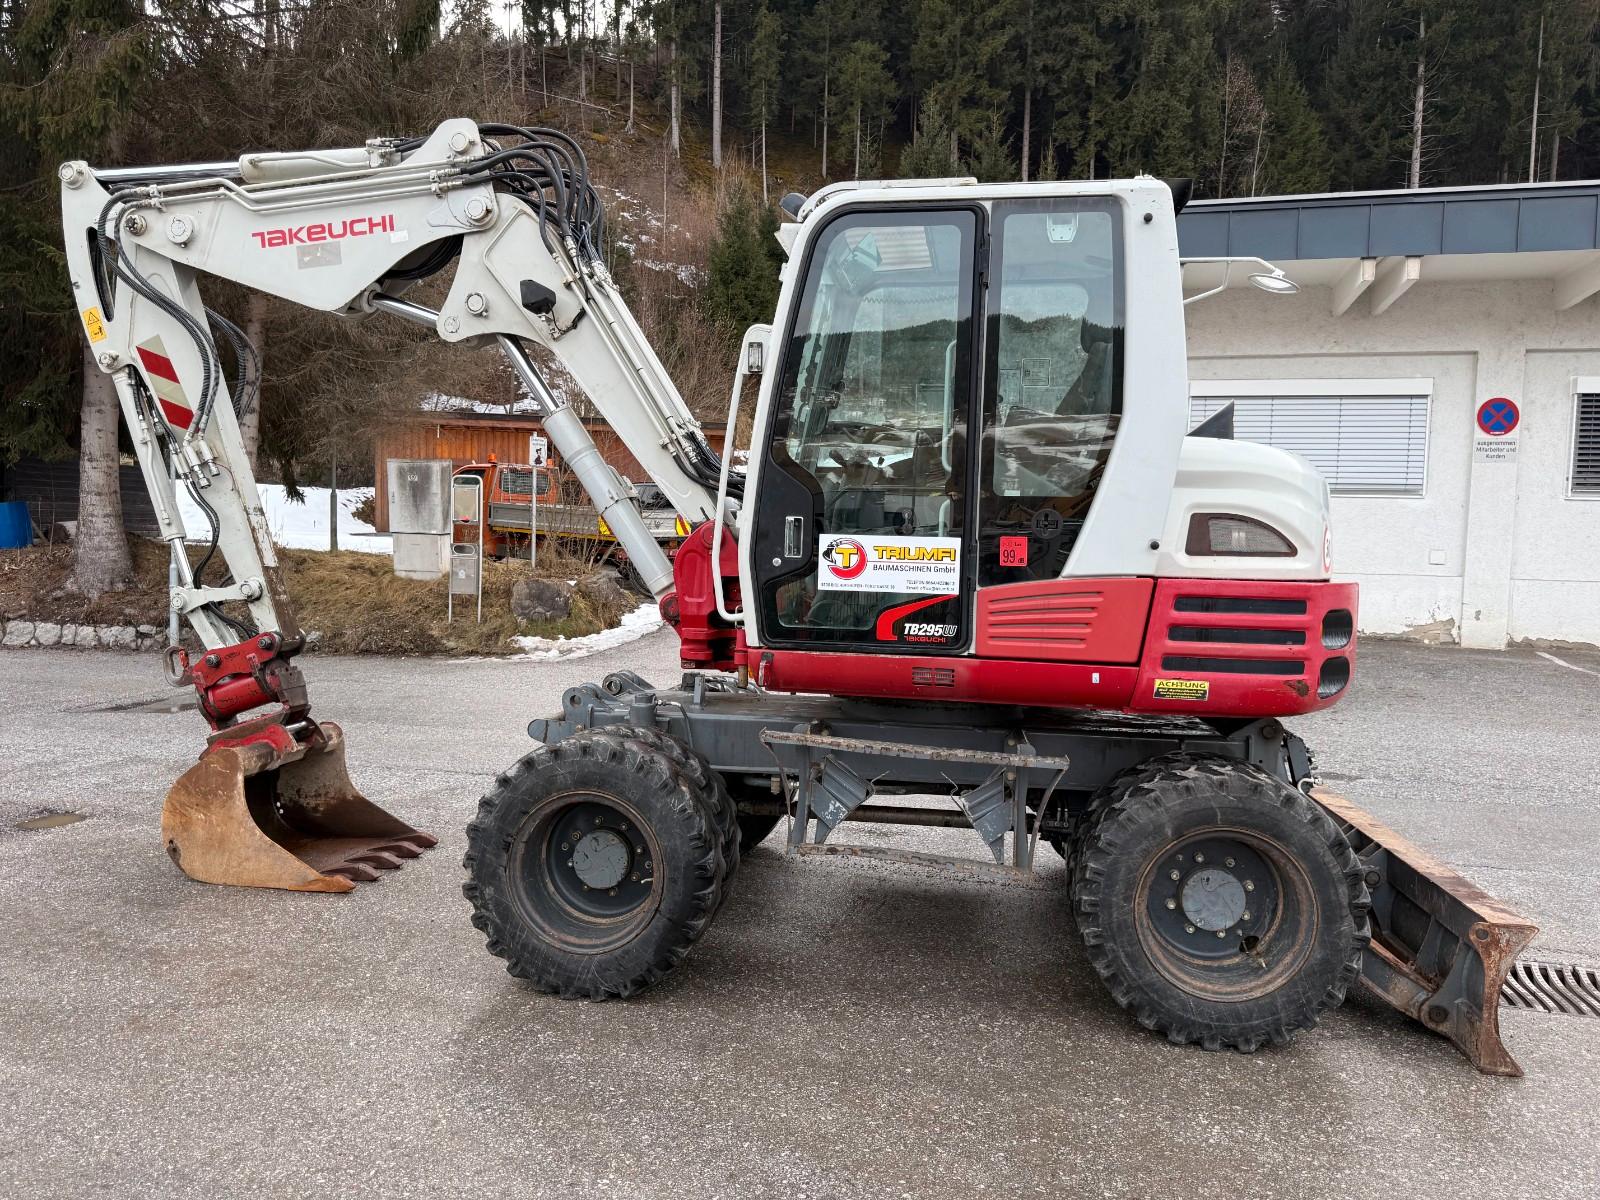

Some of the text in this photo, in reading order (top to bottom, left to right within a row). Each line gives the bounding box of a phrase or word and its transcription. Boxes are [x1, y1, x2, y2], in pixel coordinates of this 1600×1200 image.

[251, 214, 395, 249] TAKEUCHI
[873, 545, 957, 562] TRIUMFI
[1003, 549, 1016, 563] 99
[872, 564, 956, 574] BAUMASCHINEN GmbH
[903, 623, 958, 637] TB295W
[1158, 681, 1206, 689] ACHTUNG
